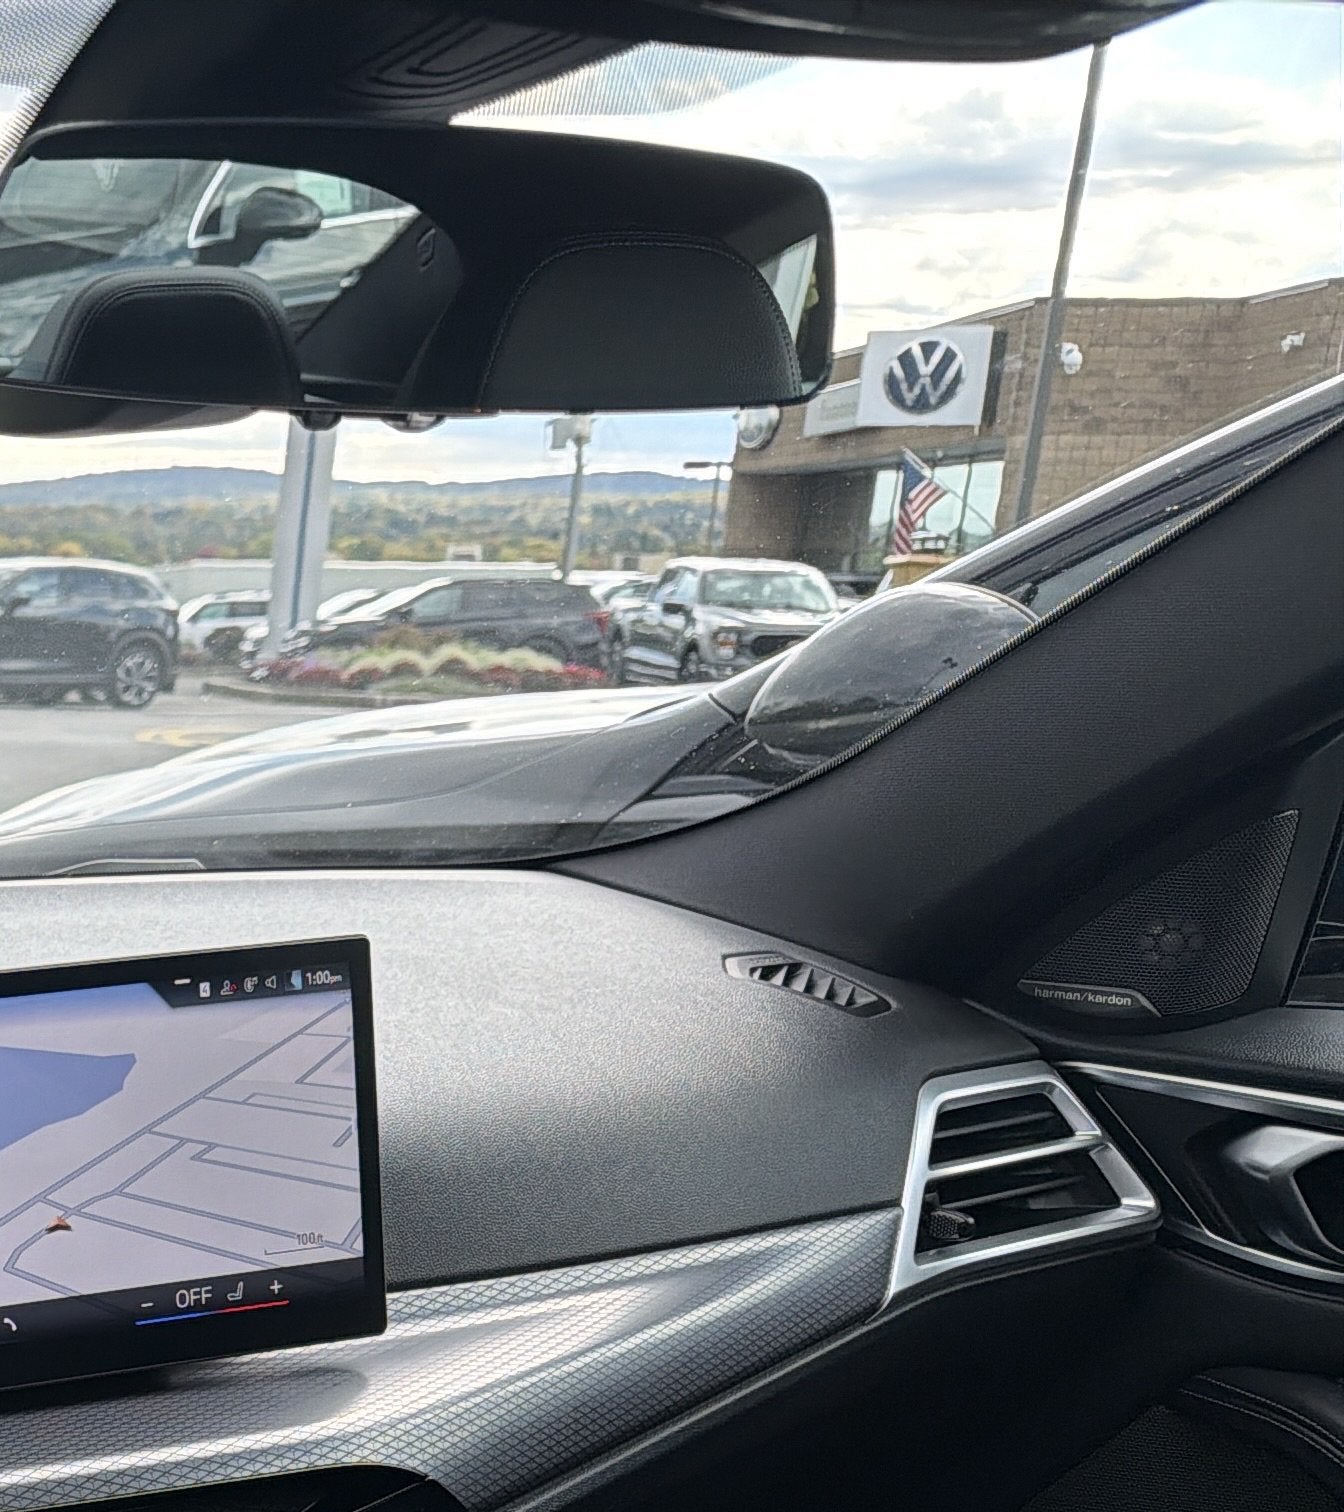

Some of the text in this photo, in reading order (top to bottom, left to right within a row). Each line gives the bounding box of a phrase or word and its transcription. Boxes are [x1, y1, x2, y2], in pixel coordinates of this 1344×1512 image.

[1034, 985, 1132, 1007] harman/kardon
[296, 1232, 315, 1246] 100
[175, 1286, 213, 1309] OFF
